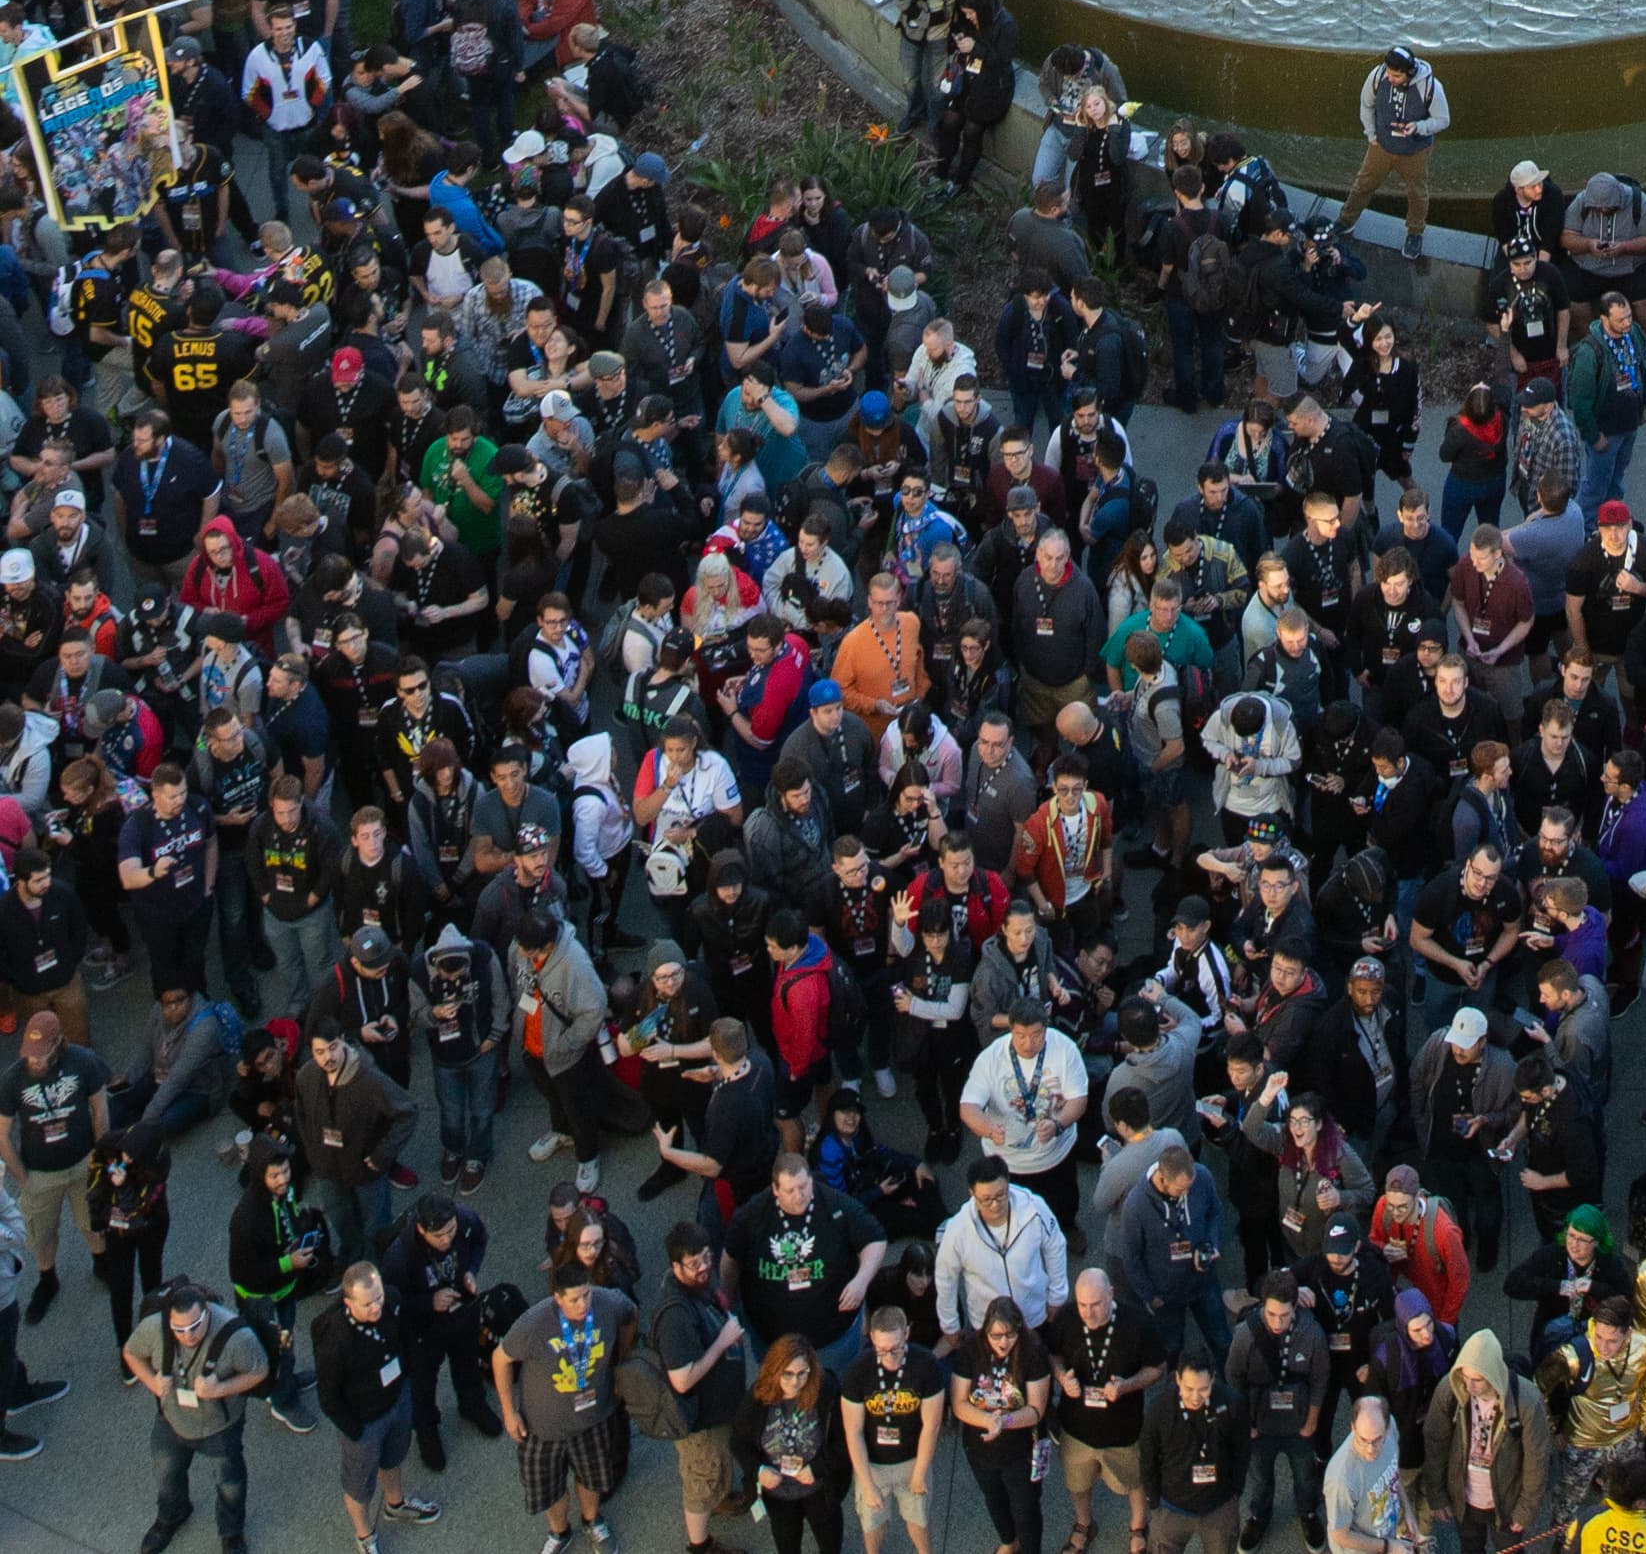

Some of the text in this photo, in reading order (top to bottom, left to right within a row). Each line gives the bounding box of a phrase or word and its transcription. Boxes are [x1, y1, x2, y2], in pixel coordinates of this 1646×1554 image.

[174, 342, 216, 359] LEMUS
[173, 363, 219, 391] 65
[759, 1258, 825, 1282] HEAER
[1605, 1526, 1645, 1550] CSC
